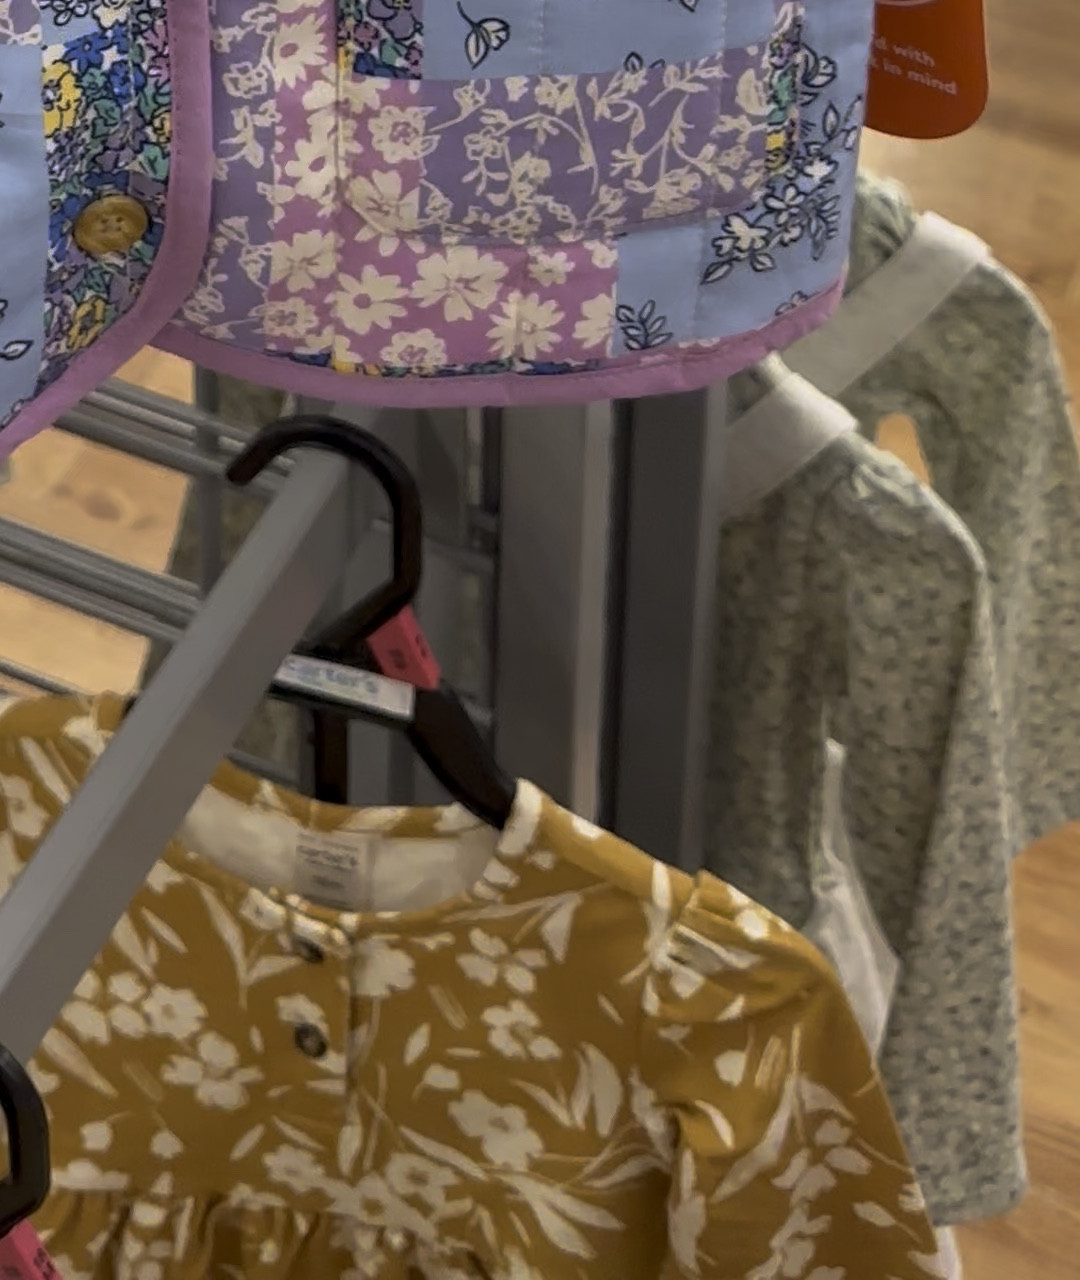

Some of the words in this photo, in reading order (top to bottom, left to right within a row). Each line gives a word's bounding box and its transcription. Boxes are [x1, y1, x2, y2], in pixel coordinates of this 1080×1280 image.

[893, 44, 935, 68] with
[883, 58, 902, 76] in
[908, 70, 957, 96] mind
